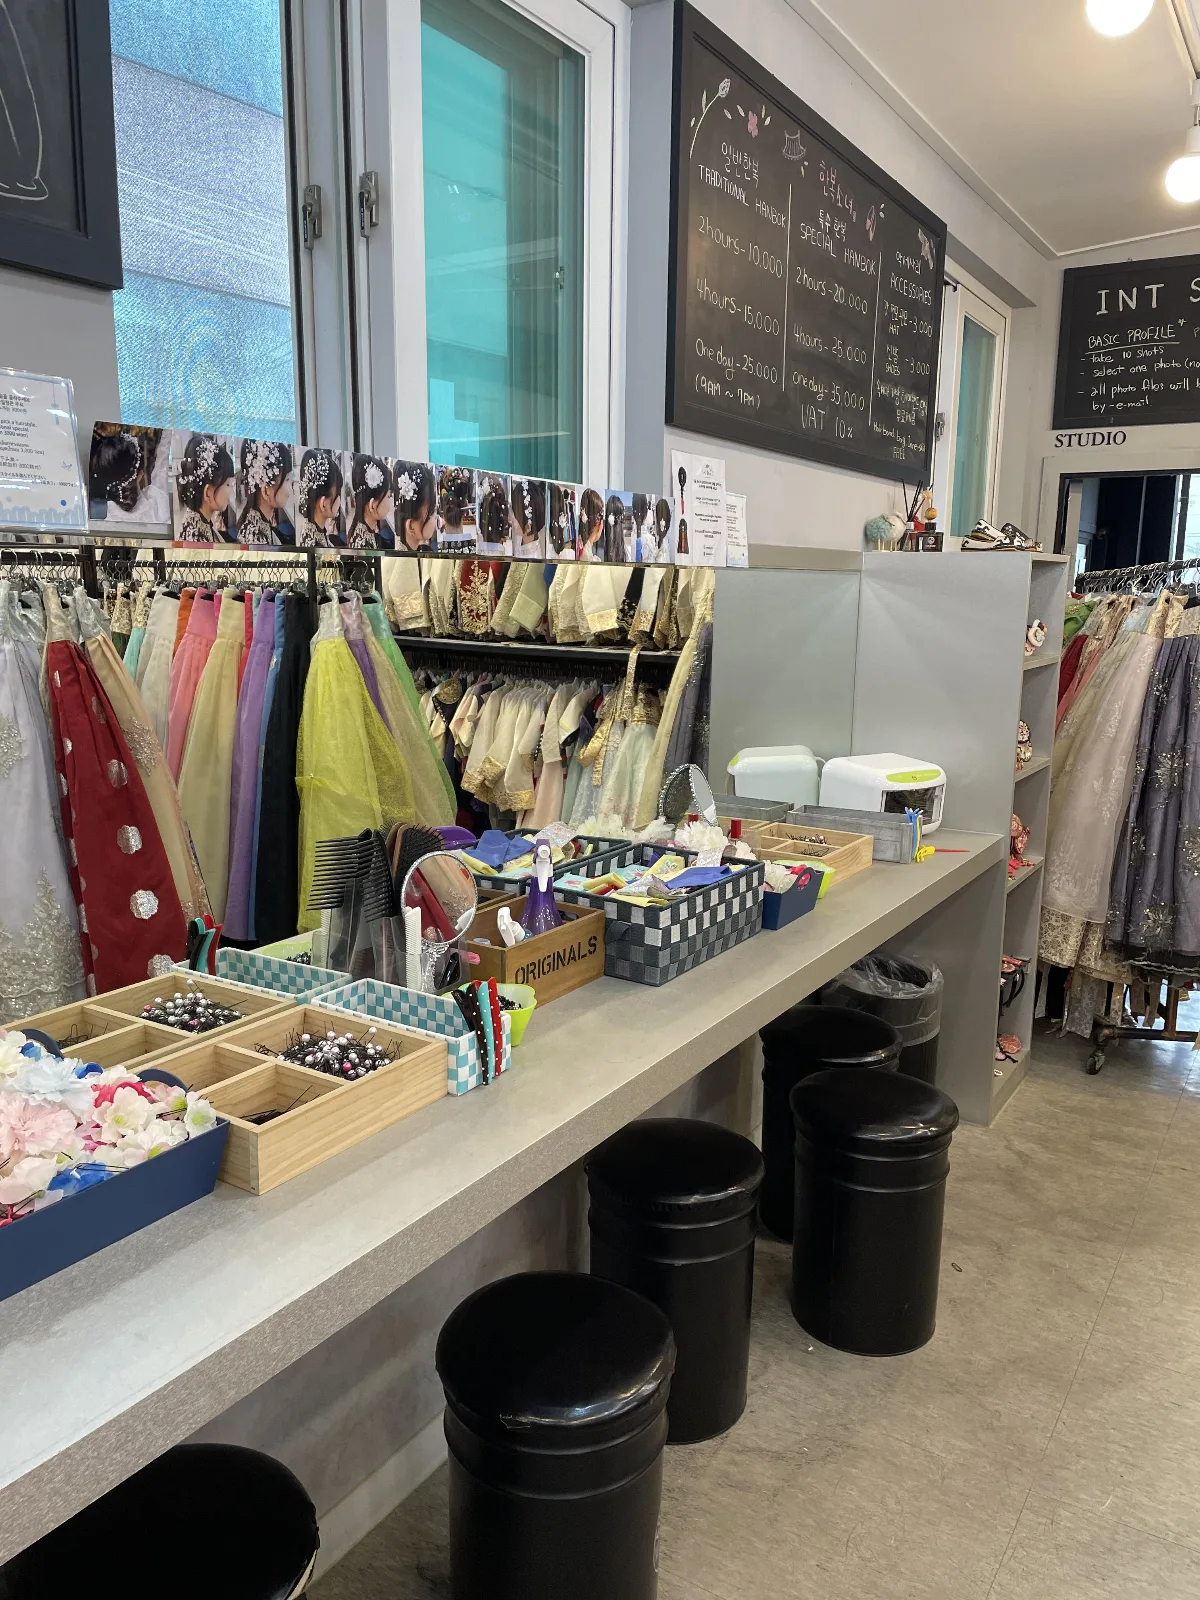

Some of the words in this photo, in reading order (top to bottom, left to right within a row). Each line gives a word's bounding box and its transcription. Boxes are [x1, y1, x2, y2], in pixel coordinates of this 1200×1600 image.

[698, 164, 749, 206] TRADITIONAL
[755, 198, 786, 228] HANBOK
[800, 222, 837, 258] SPECIAL
[844, 248, 876, 275] HANBOK
[1096, 283, 1165, 316] INT
[1088, 334, 1120, 349] BASIC
[1127, 324, 1176, 343] PROFILE
[1090, 354, 1114, 363] take
[1122, 350, 1132, 359] 10
[1136, 345, 1165, 359] shots
[1093, 365, 1125, 378] select
[1129, 364, 1148, 374] one
[1154, 359, 1182, 373] photo
[1090, 383, 1106, 397] all
[1111, 384, 1137, 399] photo
[1141, 378, 1164, 392] files
[1169, 378, 1189, 391] will
[801, 403, 826, 431] VAT
[1092, 400, 1106, 414] by
[1054, 430, 1127, 448] STUDIO
[515, 935, 598, 985] ORIGINALS
